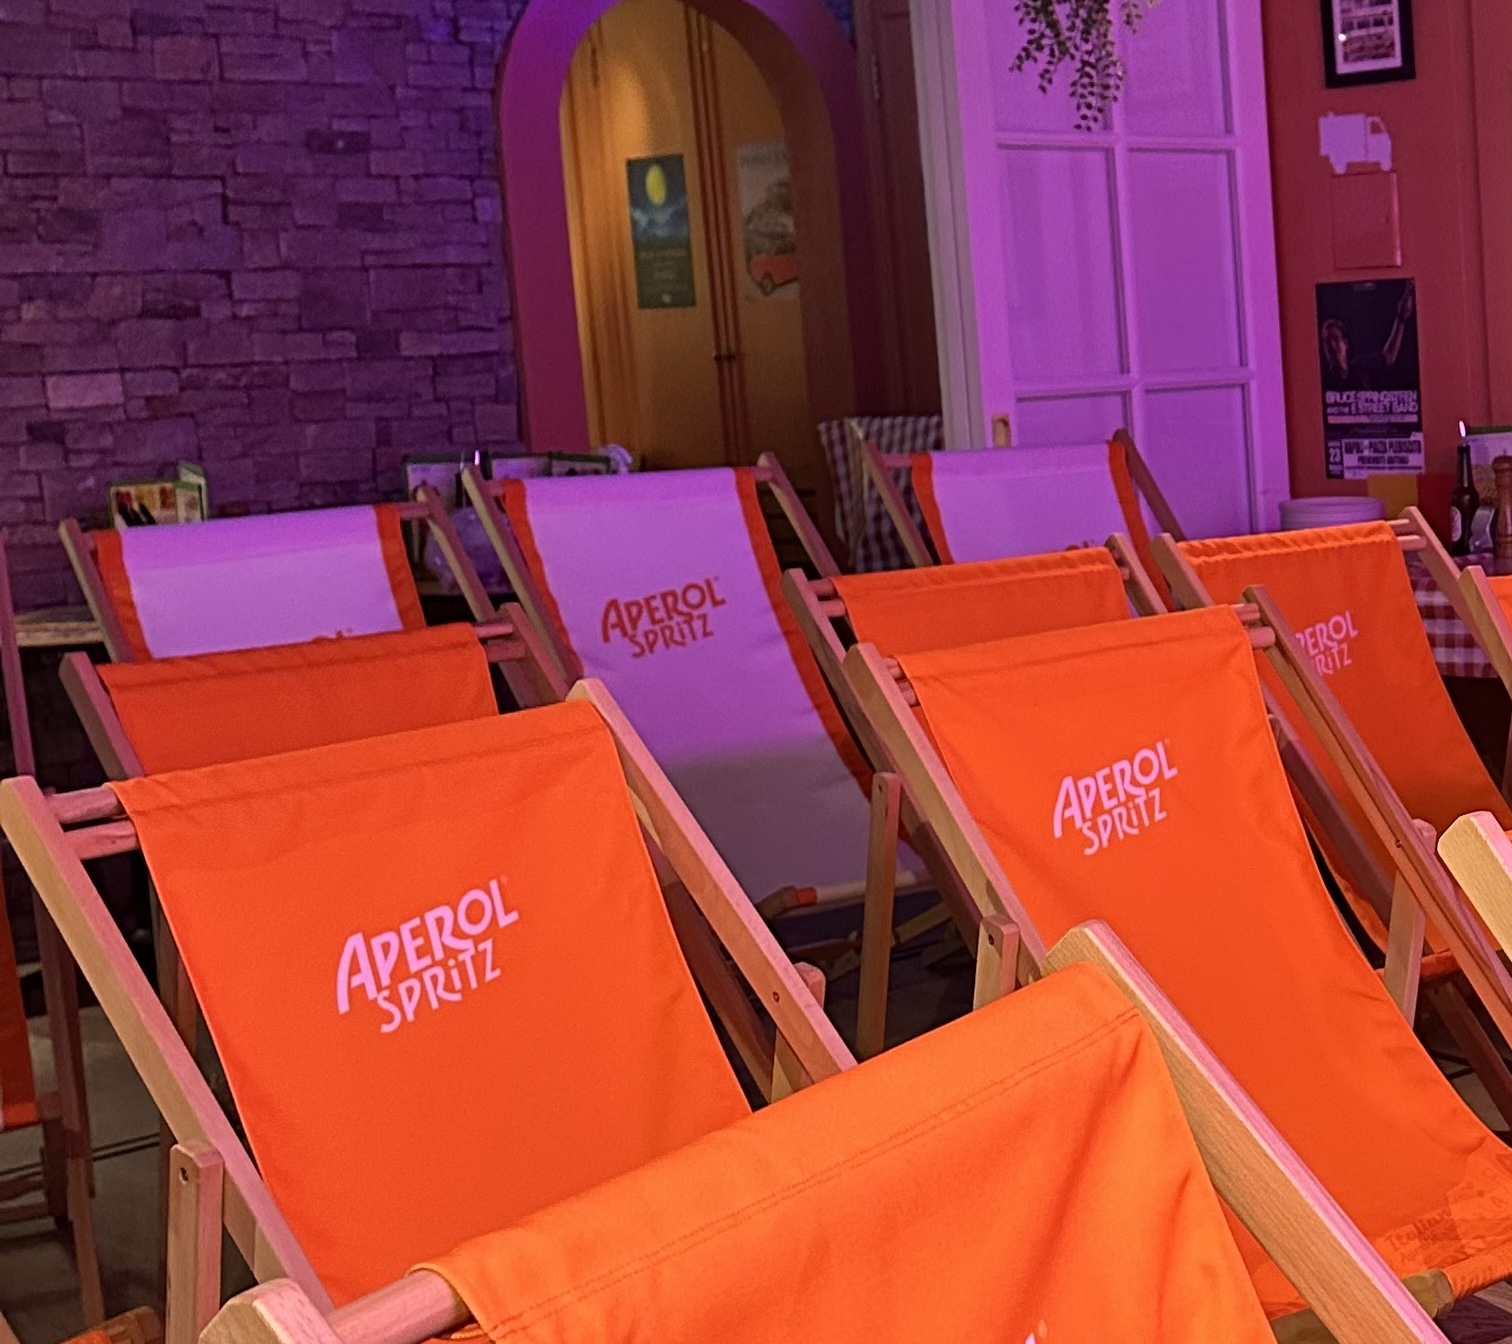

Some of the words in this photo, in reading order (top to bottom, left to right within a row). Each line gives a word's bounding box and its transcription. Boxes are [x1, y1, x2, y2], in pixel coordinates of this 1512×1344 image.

[602, 577, 726, 643] APEROL
[1052, 739, 1178, 839] APEROL
[337, 878, 519, 1015] APEROL
